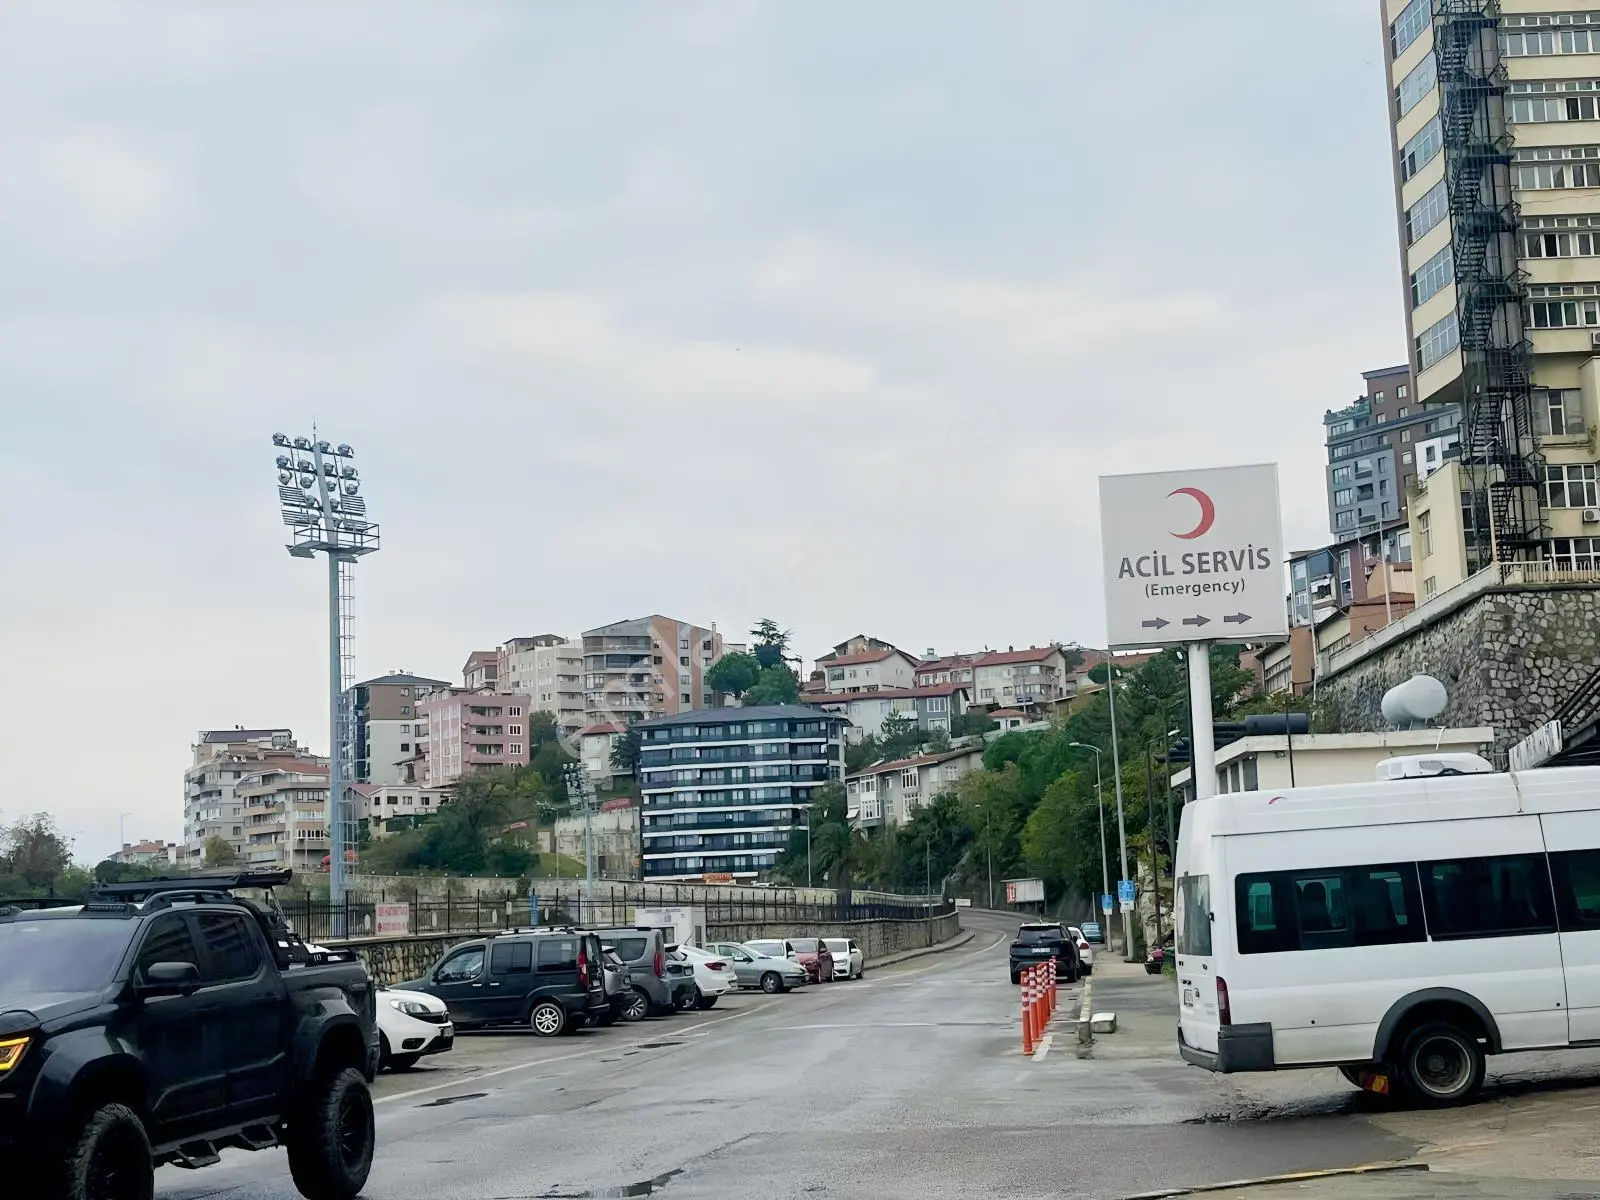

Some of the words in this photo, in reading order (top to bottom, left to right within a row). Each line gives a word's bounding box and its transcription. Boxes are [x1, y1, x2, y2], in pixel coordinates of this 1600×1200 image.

[1118, 550, 1175, 579] ACİL
[1181, 543, 1271, 575] SERVİS
[1145, 577, 1246, 598] (Emergency)
